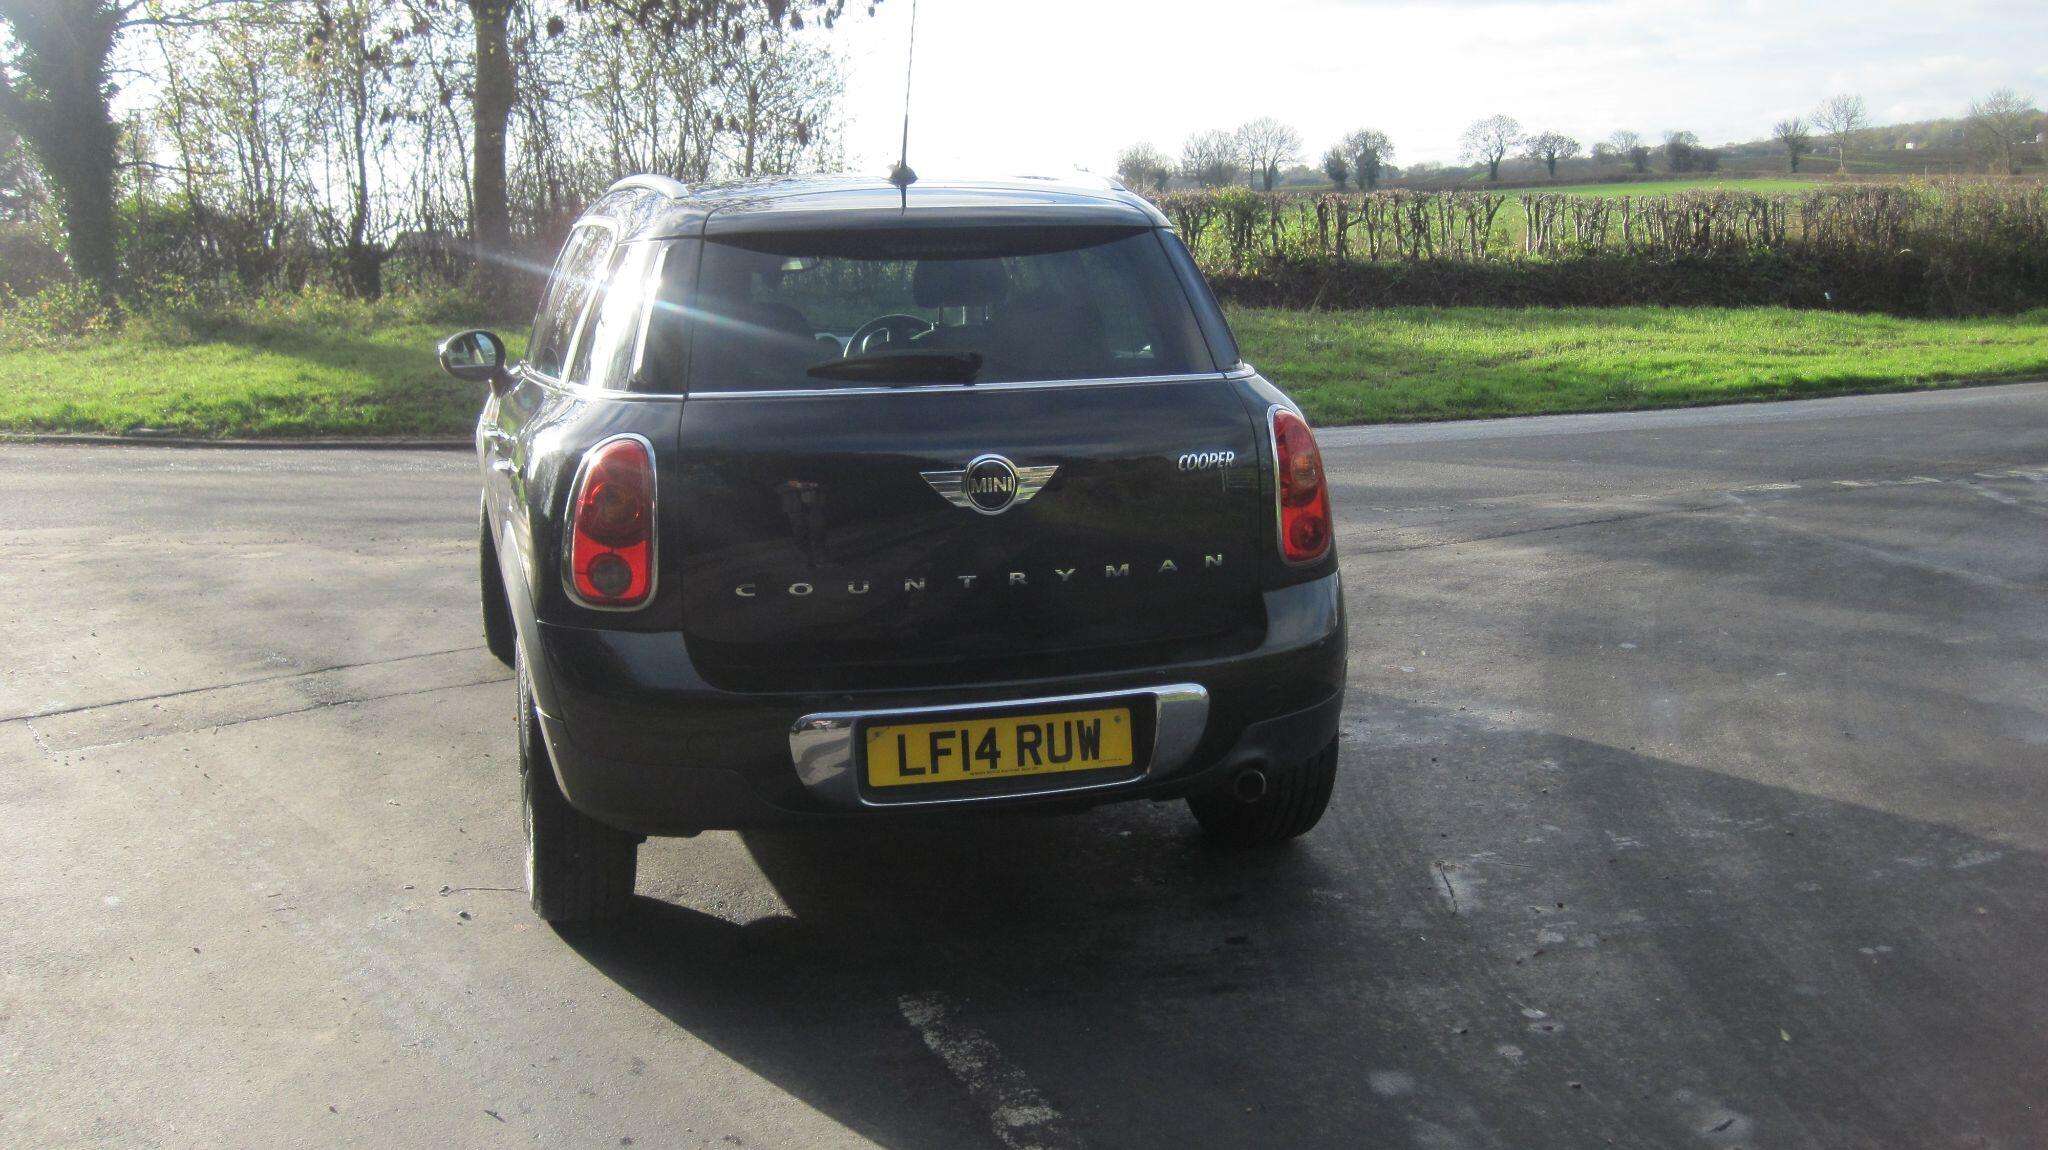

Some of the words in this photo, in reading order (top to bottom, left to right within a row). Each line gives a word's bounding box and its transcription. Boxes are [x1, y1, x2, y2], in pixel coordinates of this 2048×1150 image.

[1178, 451, 1235, 471] COOPER
[969, 476, 1013, 493] MINI
[735, 553, 1223, 597] COUNTRYMAN
[897, 727, 1001, 777] LF14
[1016, 718, 1101, 767] RUW
